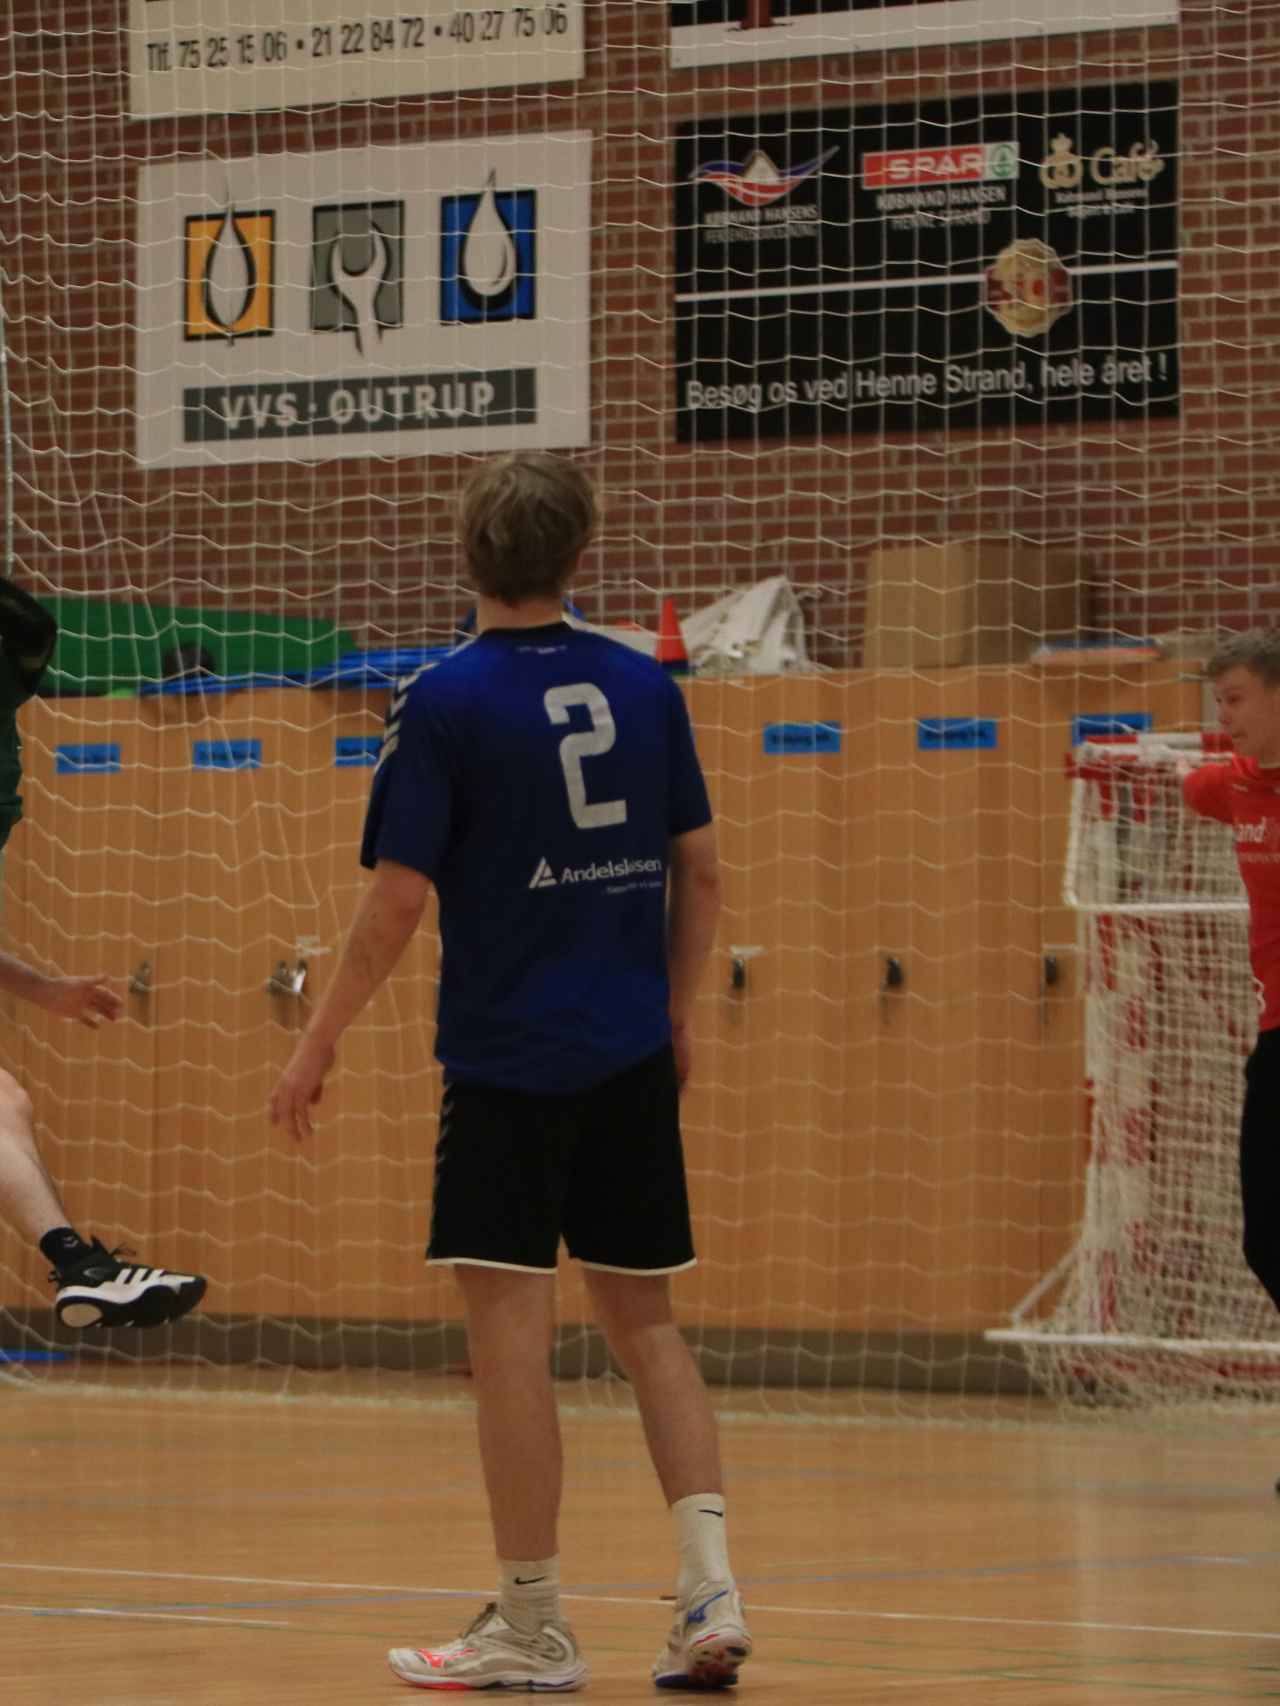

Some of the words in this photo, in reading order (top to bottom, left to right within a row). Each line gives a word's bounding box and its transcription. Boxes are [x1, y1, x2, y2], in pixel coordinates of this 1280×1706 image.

[179, 39, 200, 68] 75
[206, 36, 227, 67] 25
[237, 34, 254, 64] 15
[263, 31, 287, 62] 06
[312, 27, 331, 57] 21
[341, 23, 363, 54] 22
[371, 19, 394, 51] 84
[401, 17, 424, 48] 72
[449, 12, 474, 42] 40
[481, 10, 504, 40] 27
[512, 7, 535, 37] 75
[543, 3, 568, 34] 06
[888, 152, 982, 180] SPAR
[222, 392, 297, 429] VVS
[329, 381, 495, 424] OUTRUP
[687, 380, 762, 412] Besøg
[769, 382, 797, 402] os
[803, 370, 848, 400] ved
[855, 370, 936, 398] Henne
[945, 360, 1033, 392] Strand,
[1041, 357, 1095, 387] hele
[1101, 354, 1151, 385] året
[544, 682, 627, 829] 2
